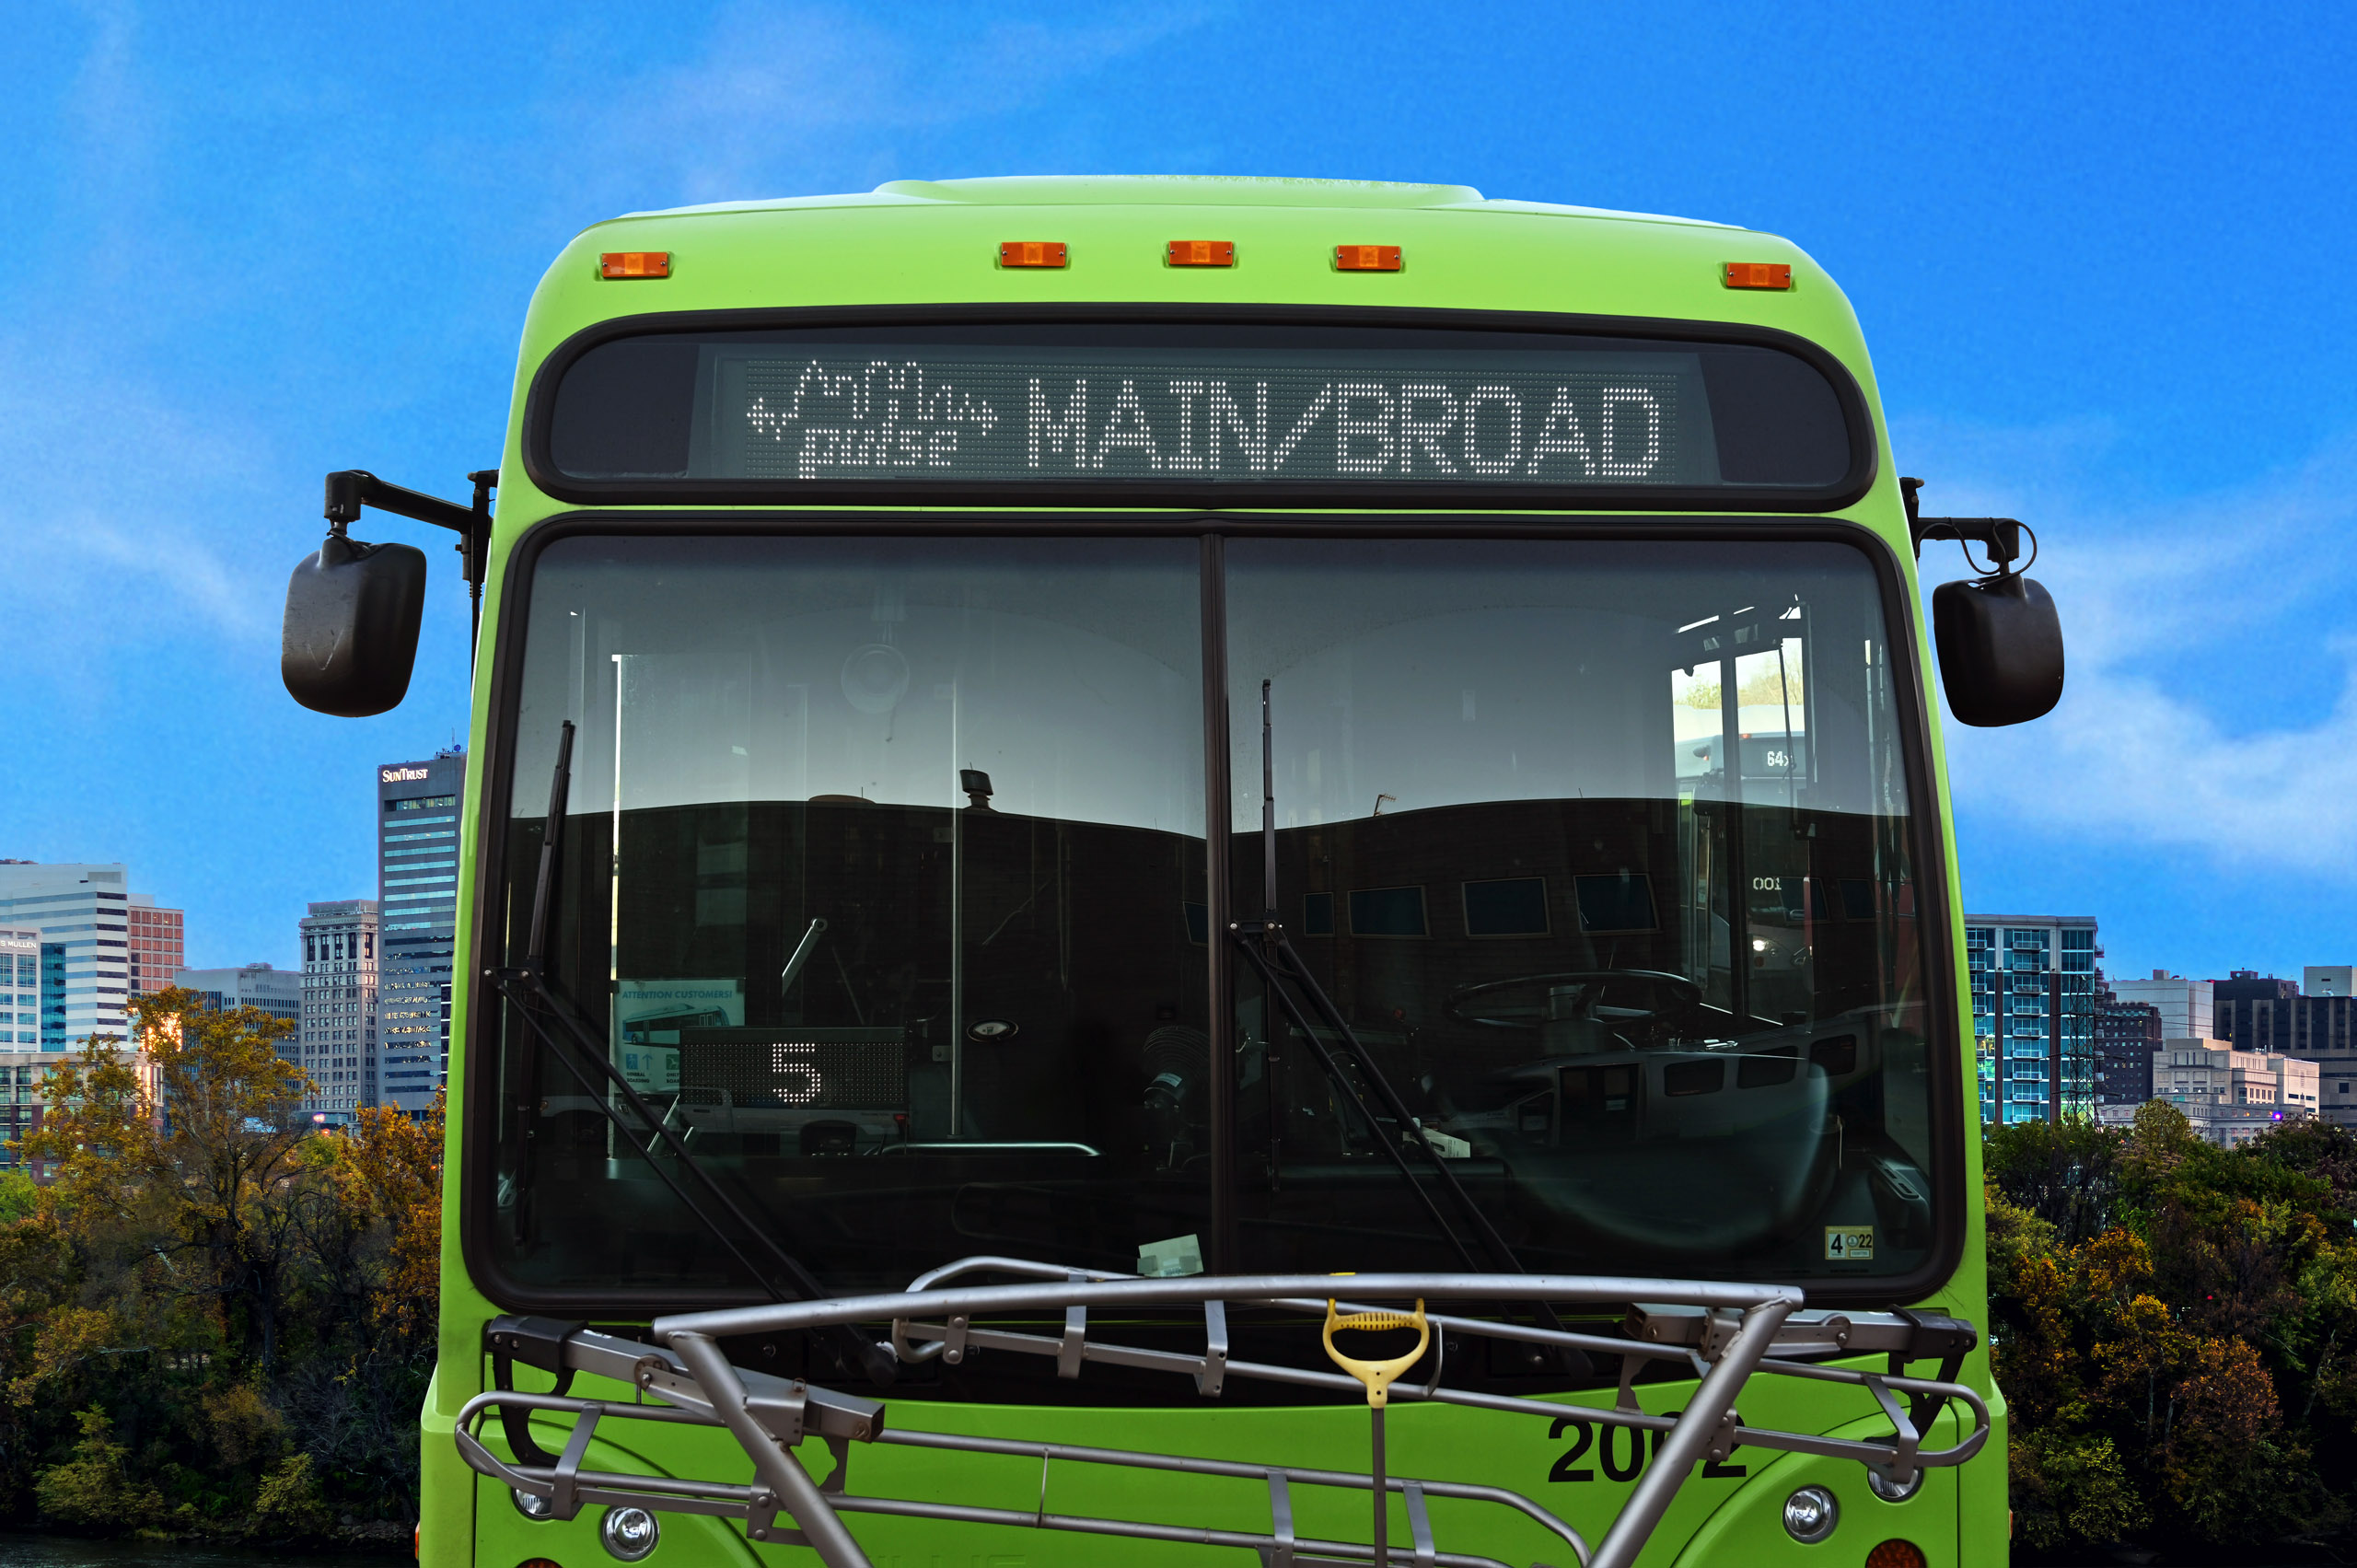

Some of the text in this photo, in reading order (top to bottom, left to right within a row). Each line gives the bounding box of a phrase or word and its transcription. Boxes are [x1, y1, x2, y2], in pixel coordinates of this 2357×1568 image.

[1028, 377, 1661, 479] MAIN/BROAD
[799, 420, 958, 480] pulse
[7, 940, 37, 948] MULLEN
[621, 990, 733, 999] ATTENTION CUSTOMERS!
[772, 1042, 821, 1103] 5
[1830, 1234, 1873, 1254] 4 22
